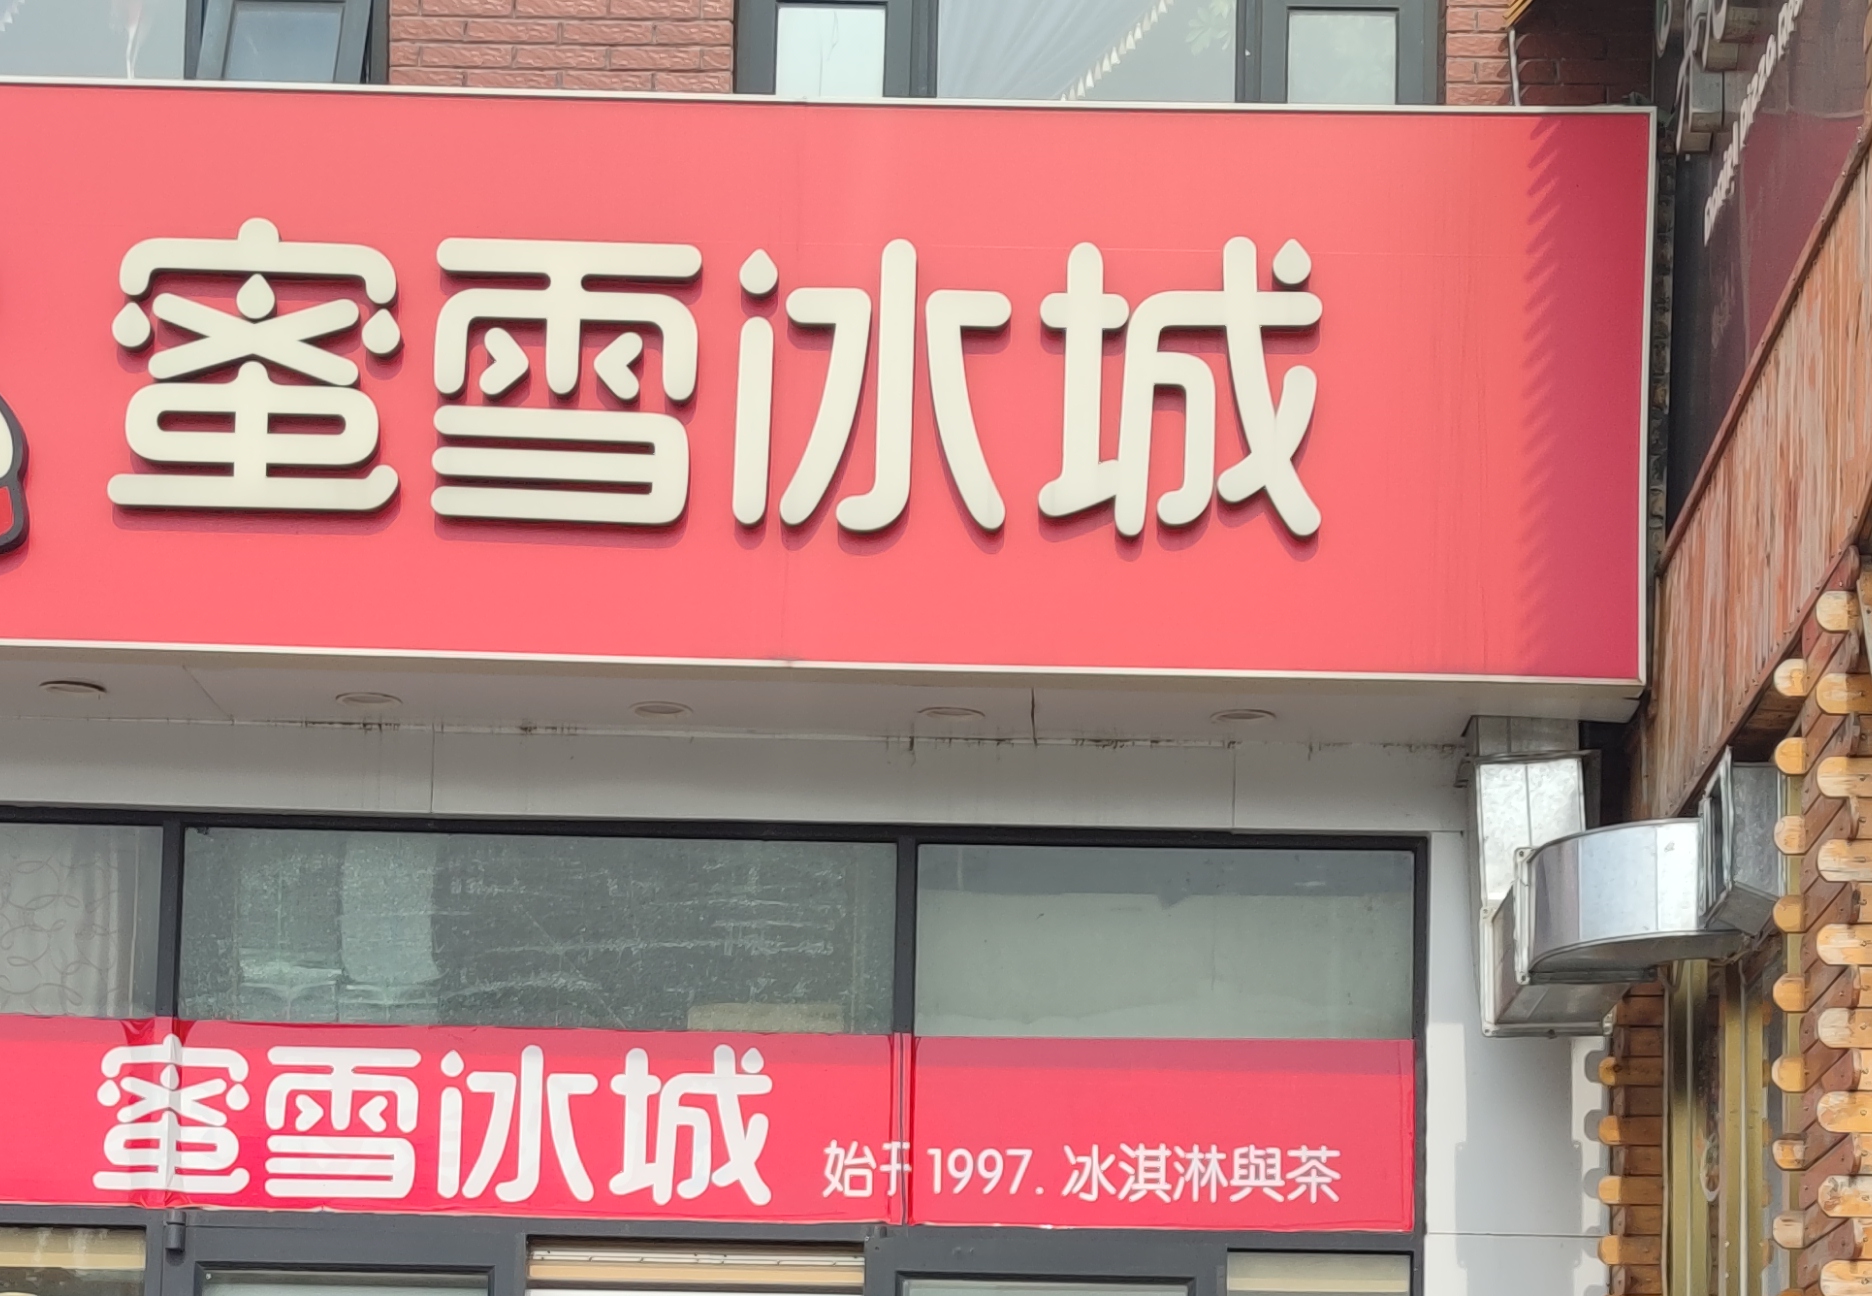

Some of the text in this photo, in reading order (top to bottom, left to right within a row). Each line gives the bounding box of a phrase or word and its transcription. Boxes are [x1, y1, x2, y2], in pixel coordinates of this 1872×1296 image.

[107, 218, 1323, 537] 蜜雪冰城
[91, 1033, 774, 1205] 蜜雪冰城
